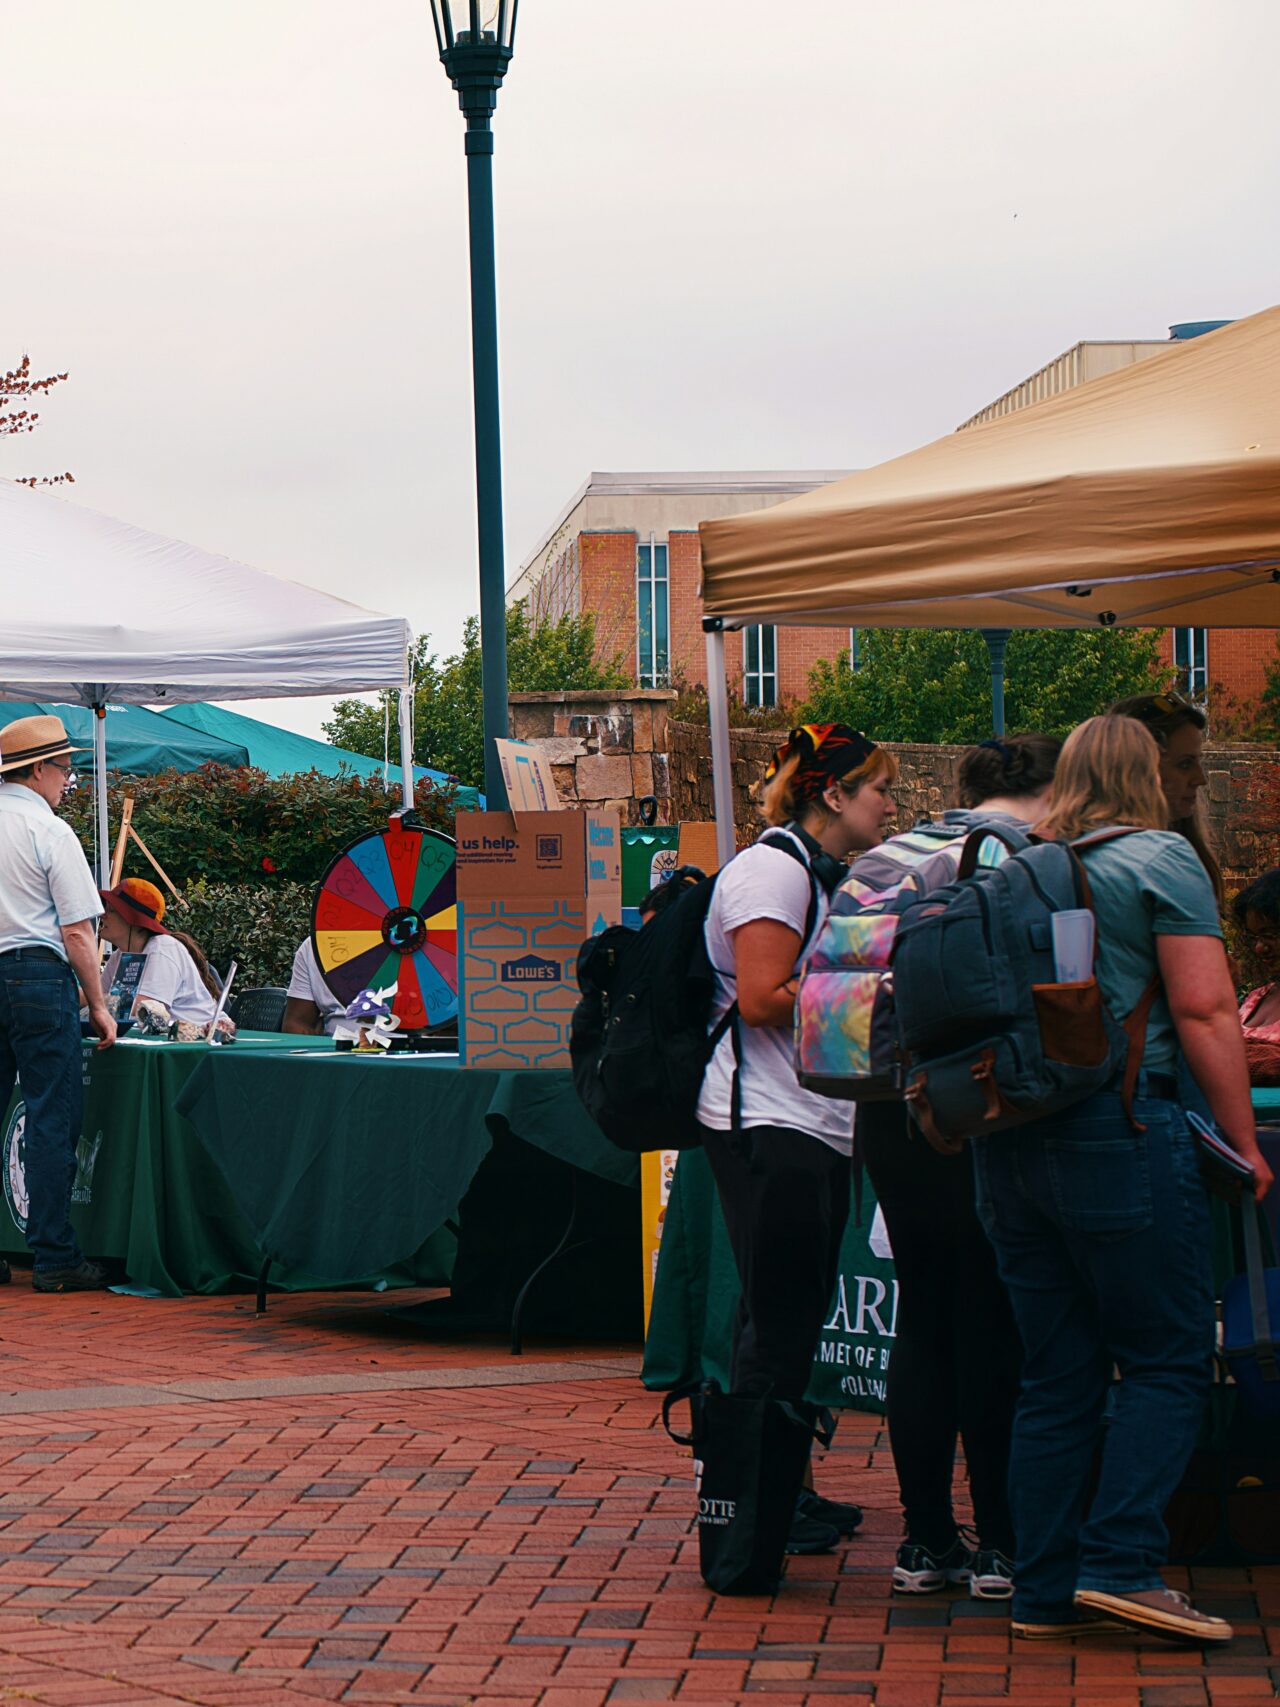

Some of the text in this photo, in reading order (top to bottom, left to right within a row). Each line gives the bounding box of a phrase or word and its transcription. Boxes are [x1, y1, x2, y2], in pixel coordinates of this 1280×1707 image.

[462, 839, 479, 850] us
[482, 835, 520, 852] help.
[421, 845, 451, 873] Q5
[506, 965, 555, 979] LOWE'S
[814, 1341, 852, 1366] MET
[855, 1346, 877, 1368] OF
